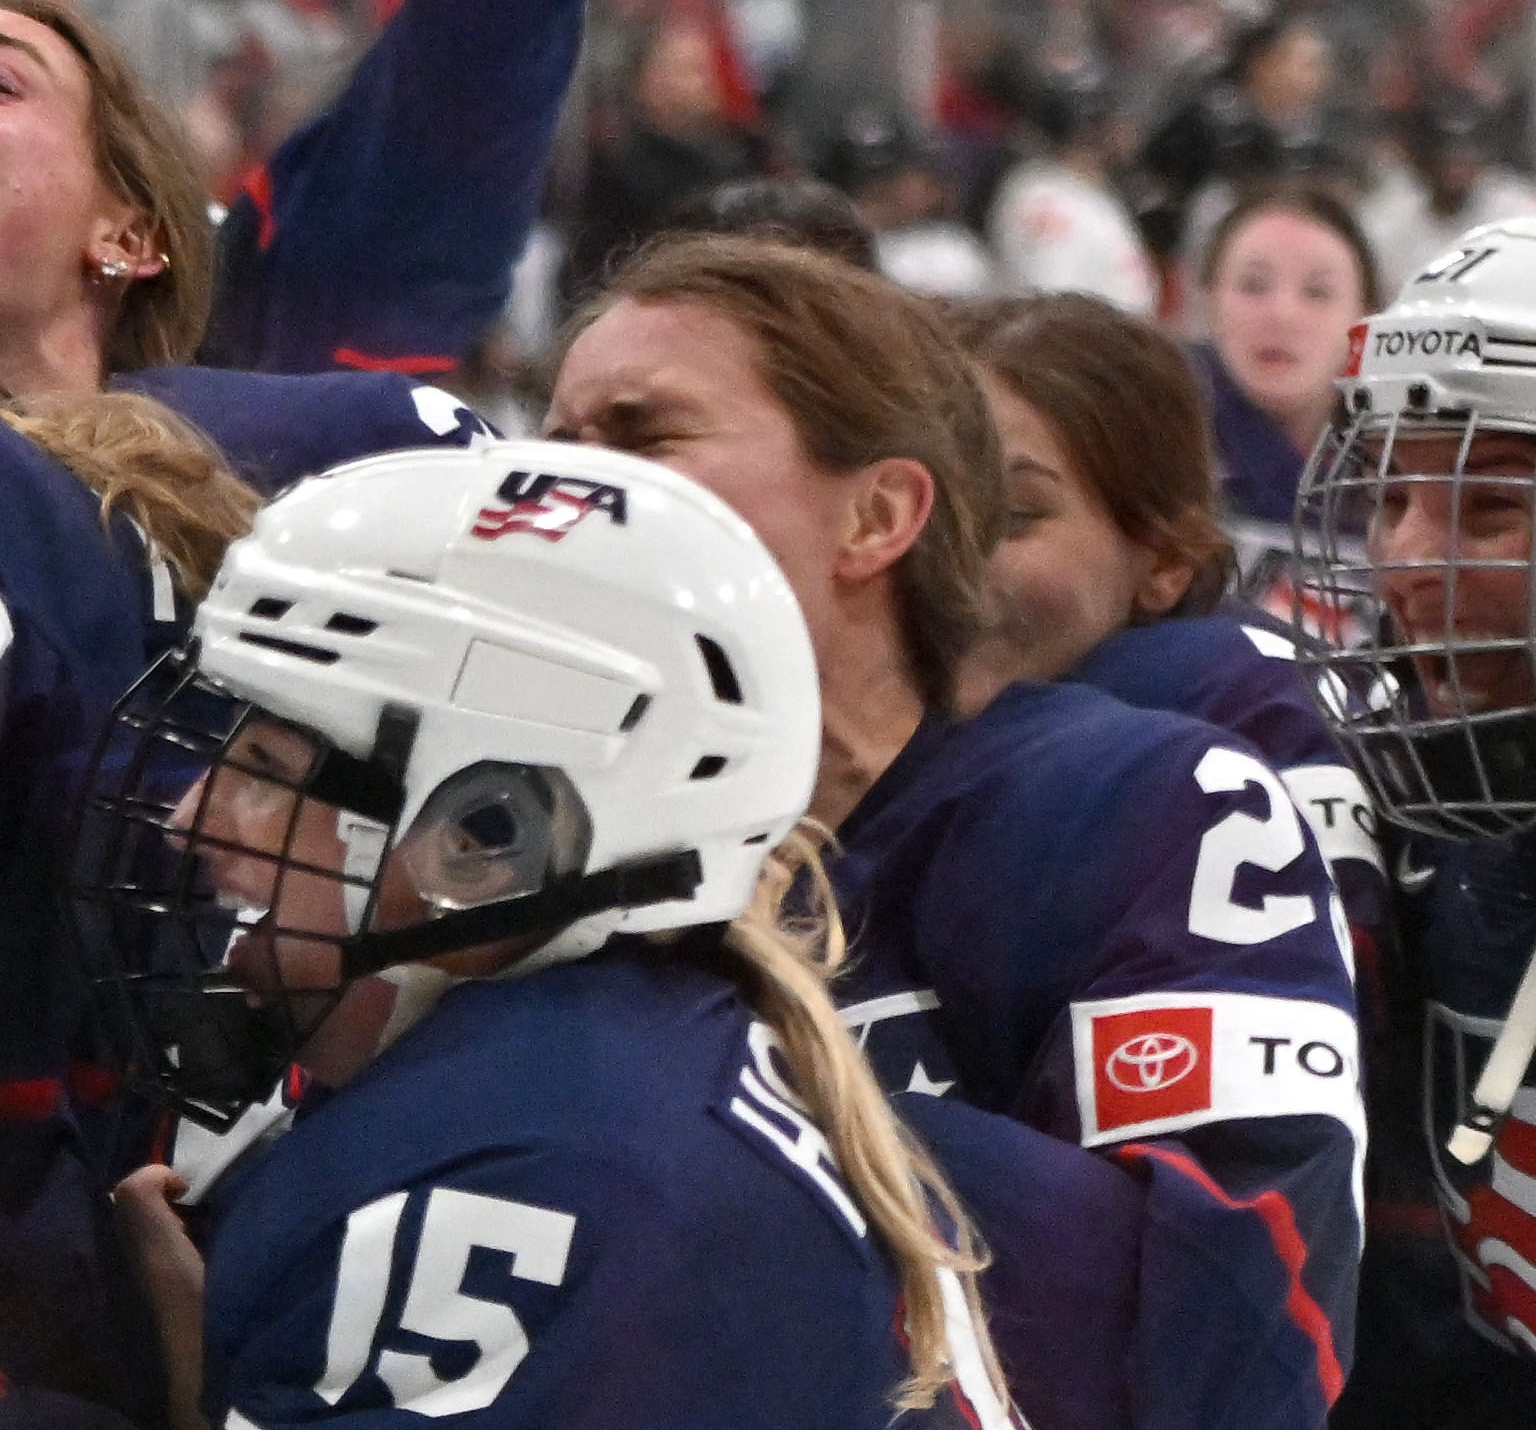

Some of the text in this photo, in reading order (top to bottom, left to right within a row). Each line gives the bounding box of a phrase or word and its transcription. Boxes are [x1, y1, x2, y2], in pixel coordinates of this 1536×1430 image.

[1374, 329, 1482, 361] TOYOTA
[471, 470, 629, 542] USA
[314, 1186, 577, 1419] 15
